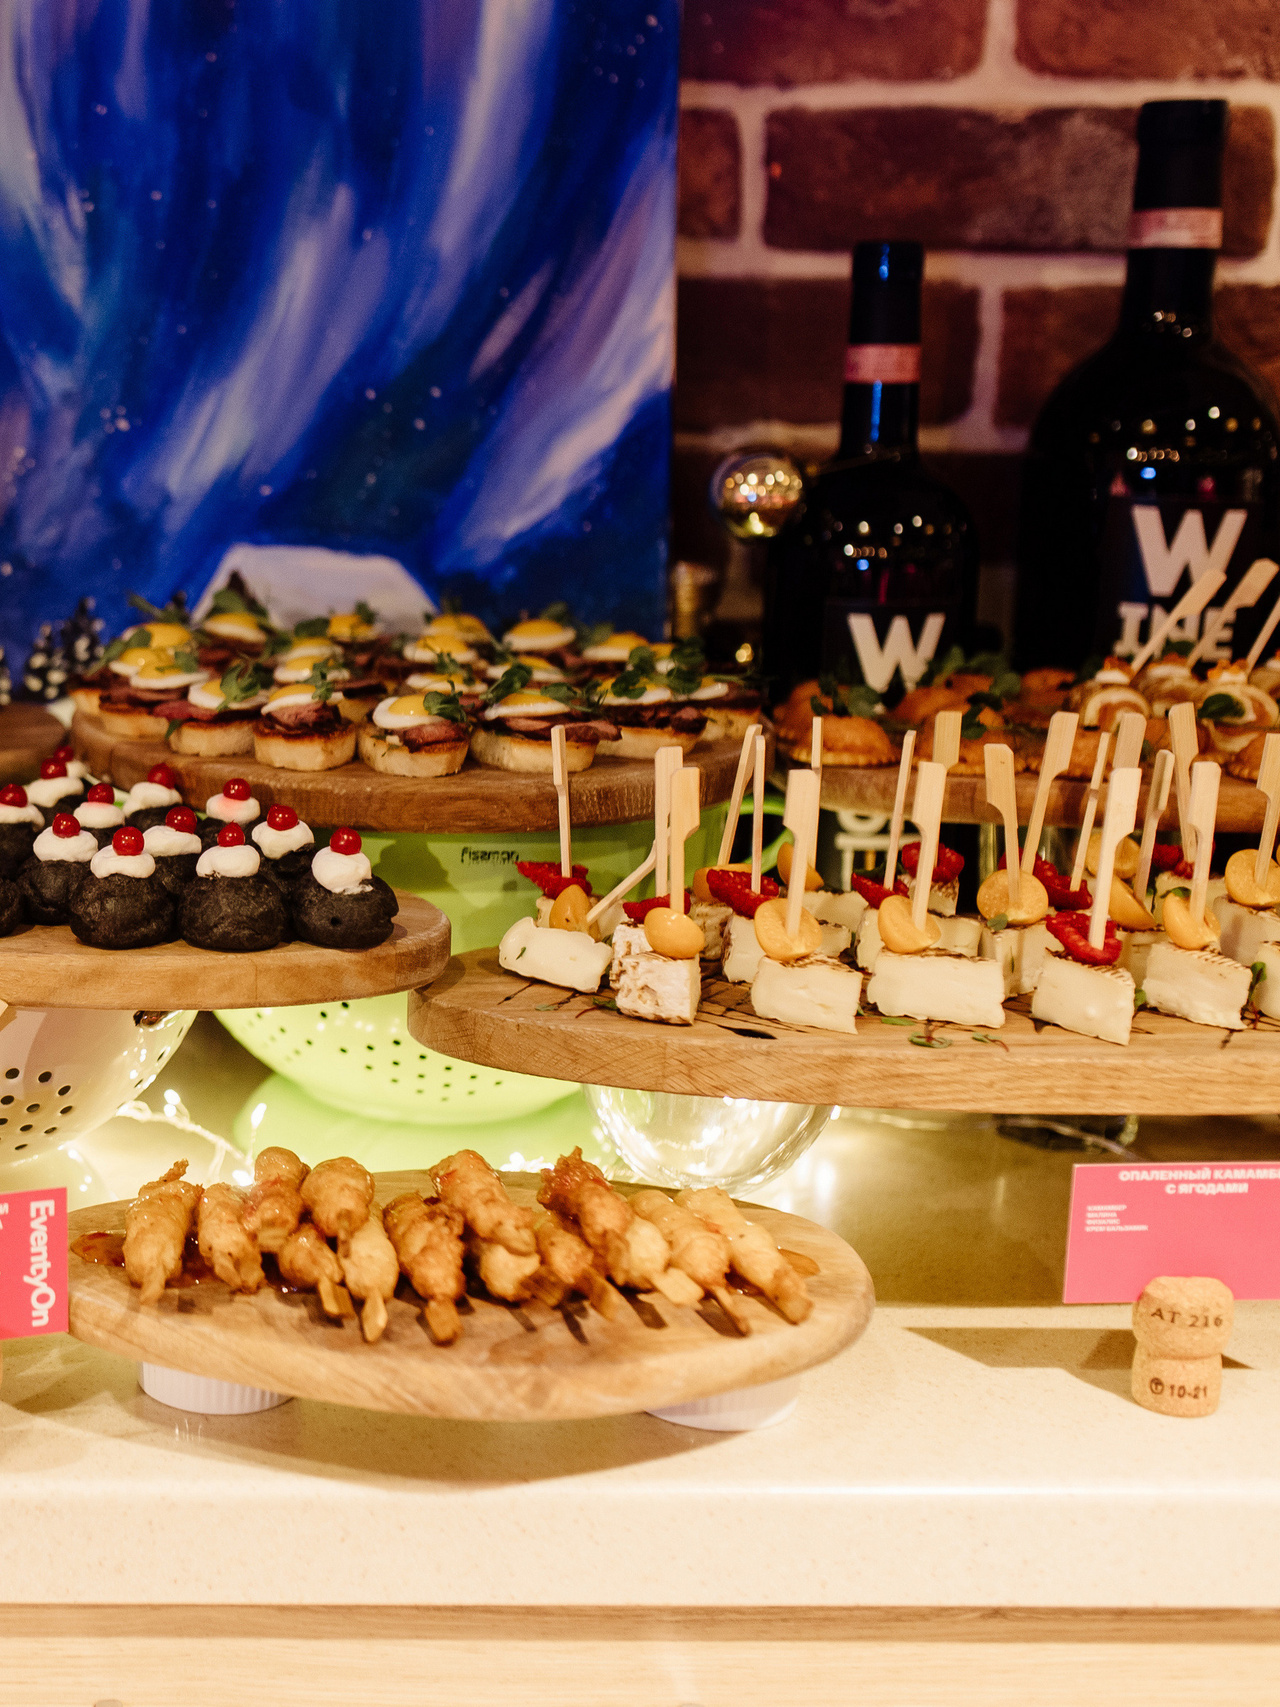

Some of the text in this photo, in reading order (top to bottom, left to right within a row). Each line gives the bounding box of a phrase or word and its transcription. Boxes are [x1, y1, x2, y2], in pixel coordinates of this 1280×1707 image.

[1131, 504, 1248, 598] W
[847, 612, 946, 693] W
[1119, 1167, 1280, 1181] ОПАЛЕННЫЙ КАМАМБ
[1165, 1182, 1248, 1196] С ЯГОДАМИ
[23, 1199, 56, 1328] EventyOn
[1151, 1308, 1223, 1328] AT 216
